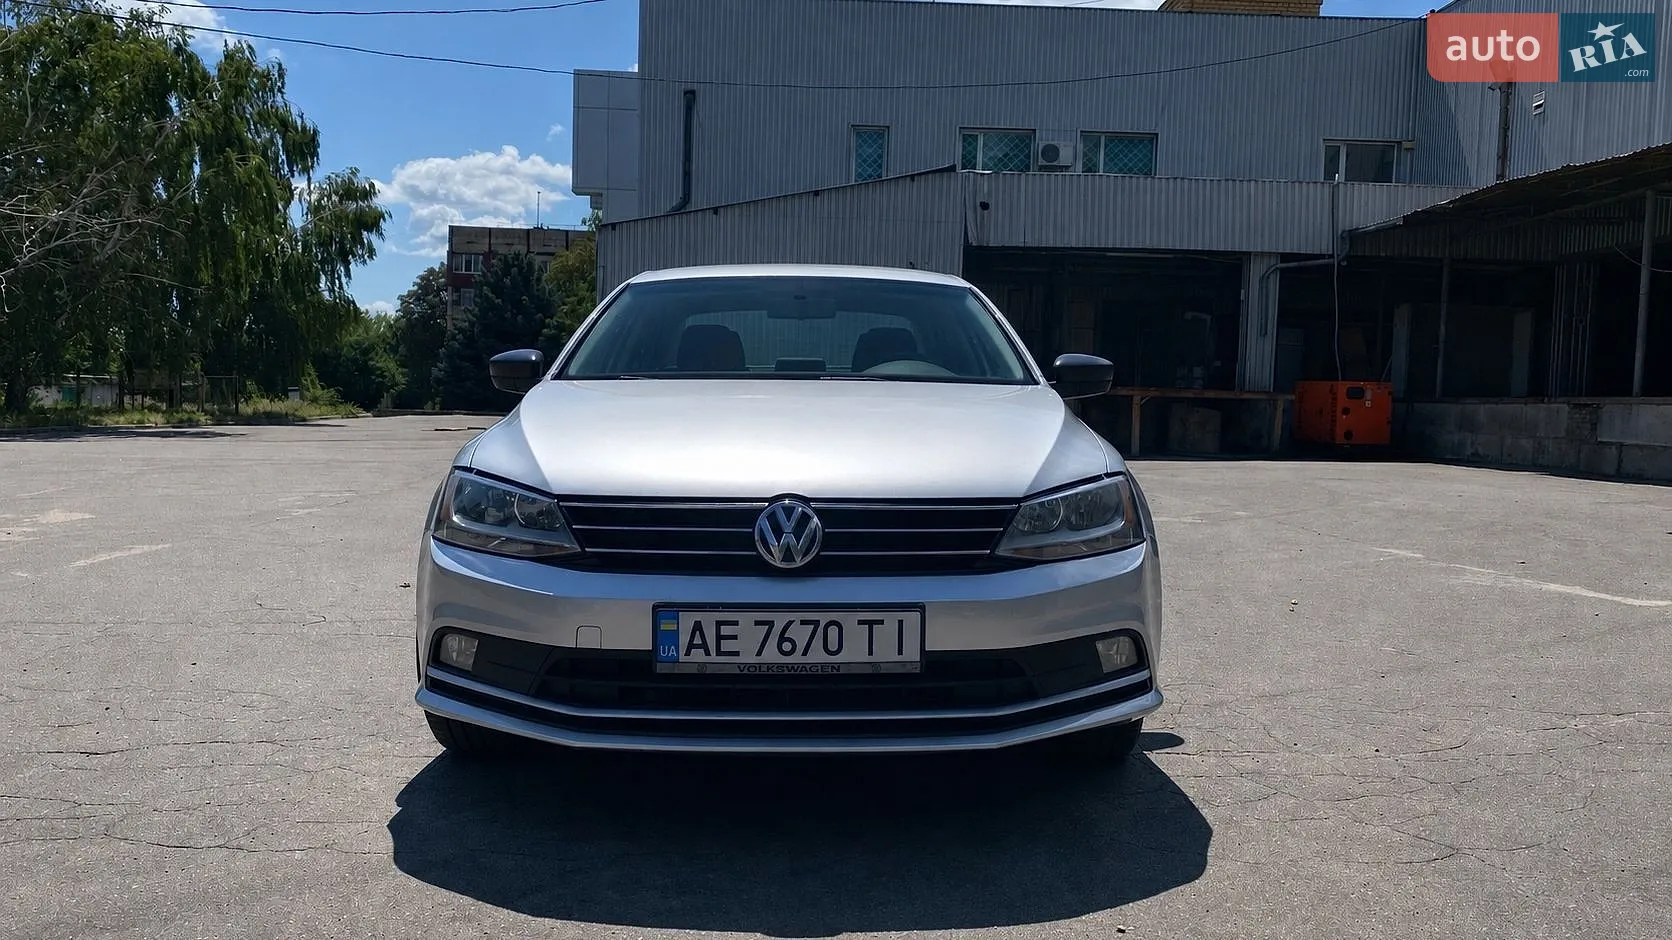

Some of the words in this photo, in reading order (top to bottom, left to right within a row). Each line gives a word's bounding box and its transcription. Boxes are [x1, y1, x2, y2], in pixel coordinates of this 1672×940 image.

[683, 619, 740, 657] AE
[753, 619, 844, 657] 7670
[659, 645, 677, 657] UA
[736, 664, 841, 673] VOLKSWAGEN
